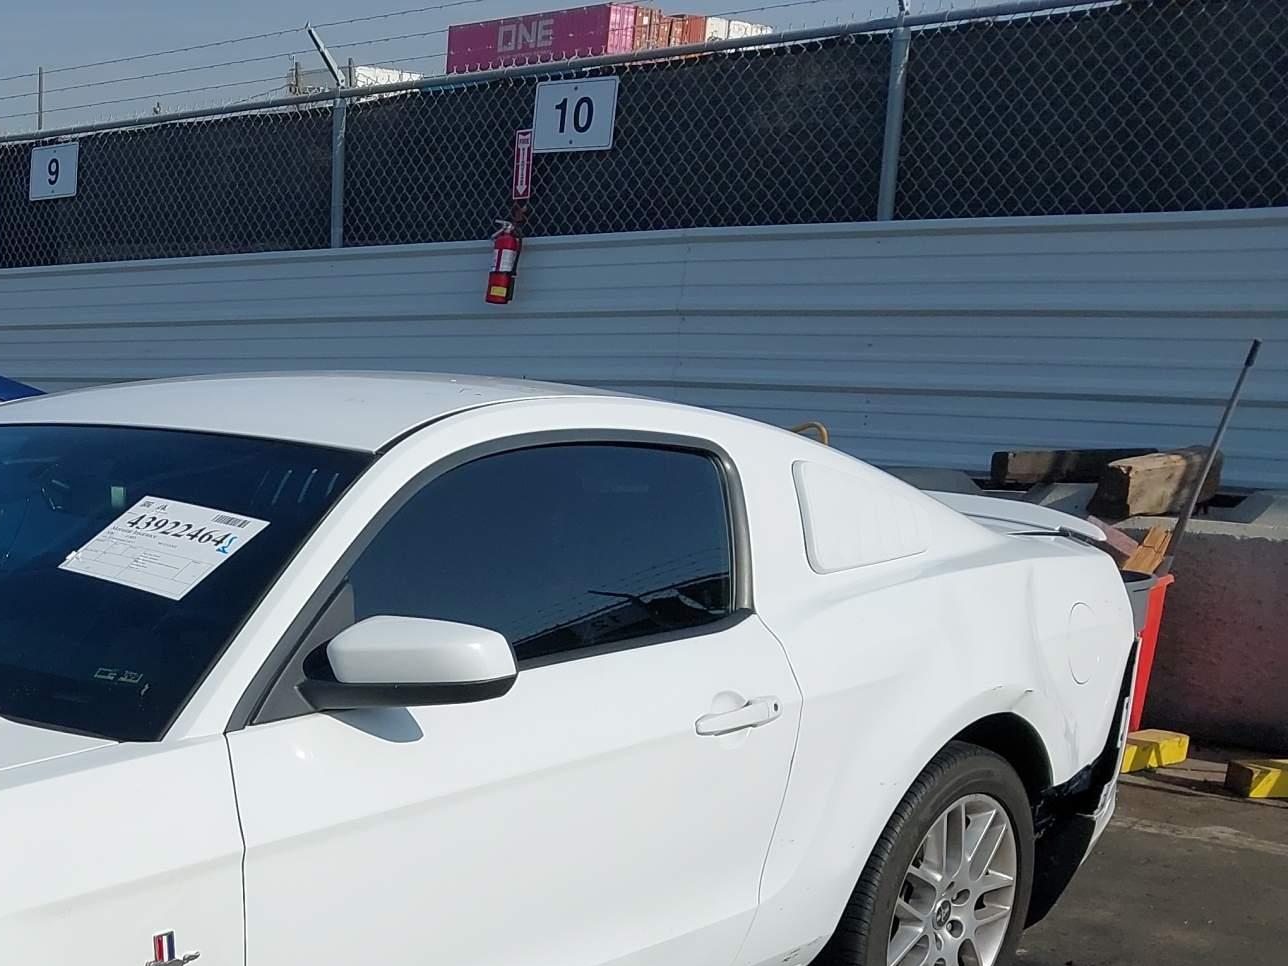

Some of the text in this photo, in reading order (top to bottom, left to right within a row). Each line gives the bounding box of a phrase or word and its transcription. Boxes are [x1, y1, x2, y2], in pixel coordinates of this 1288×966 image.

[497, 19, 554, 52] ONE
[555, 97, 594, 133] 10
[48, 158, 59, 185] 9
[127, 514, 229, 546] 43922464
